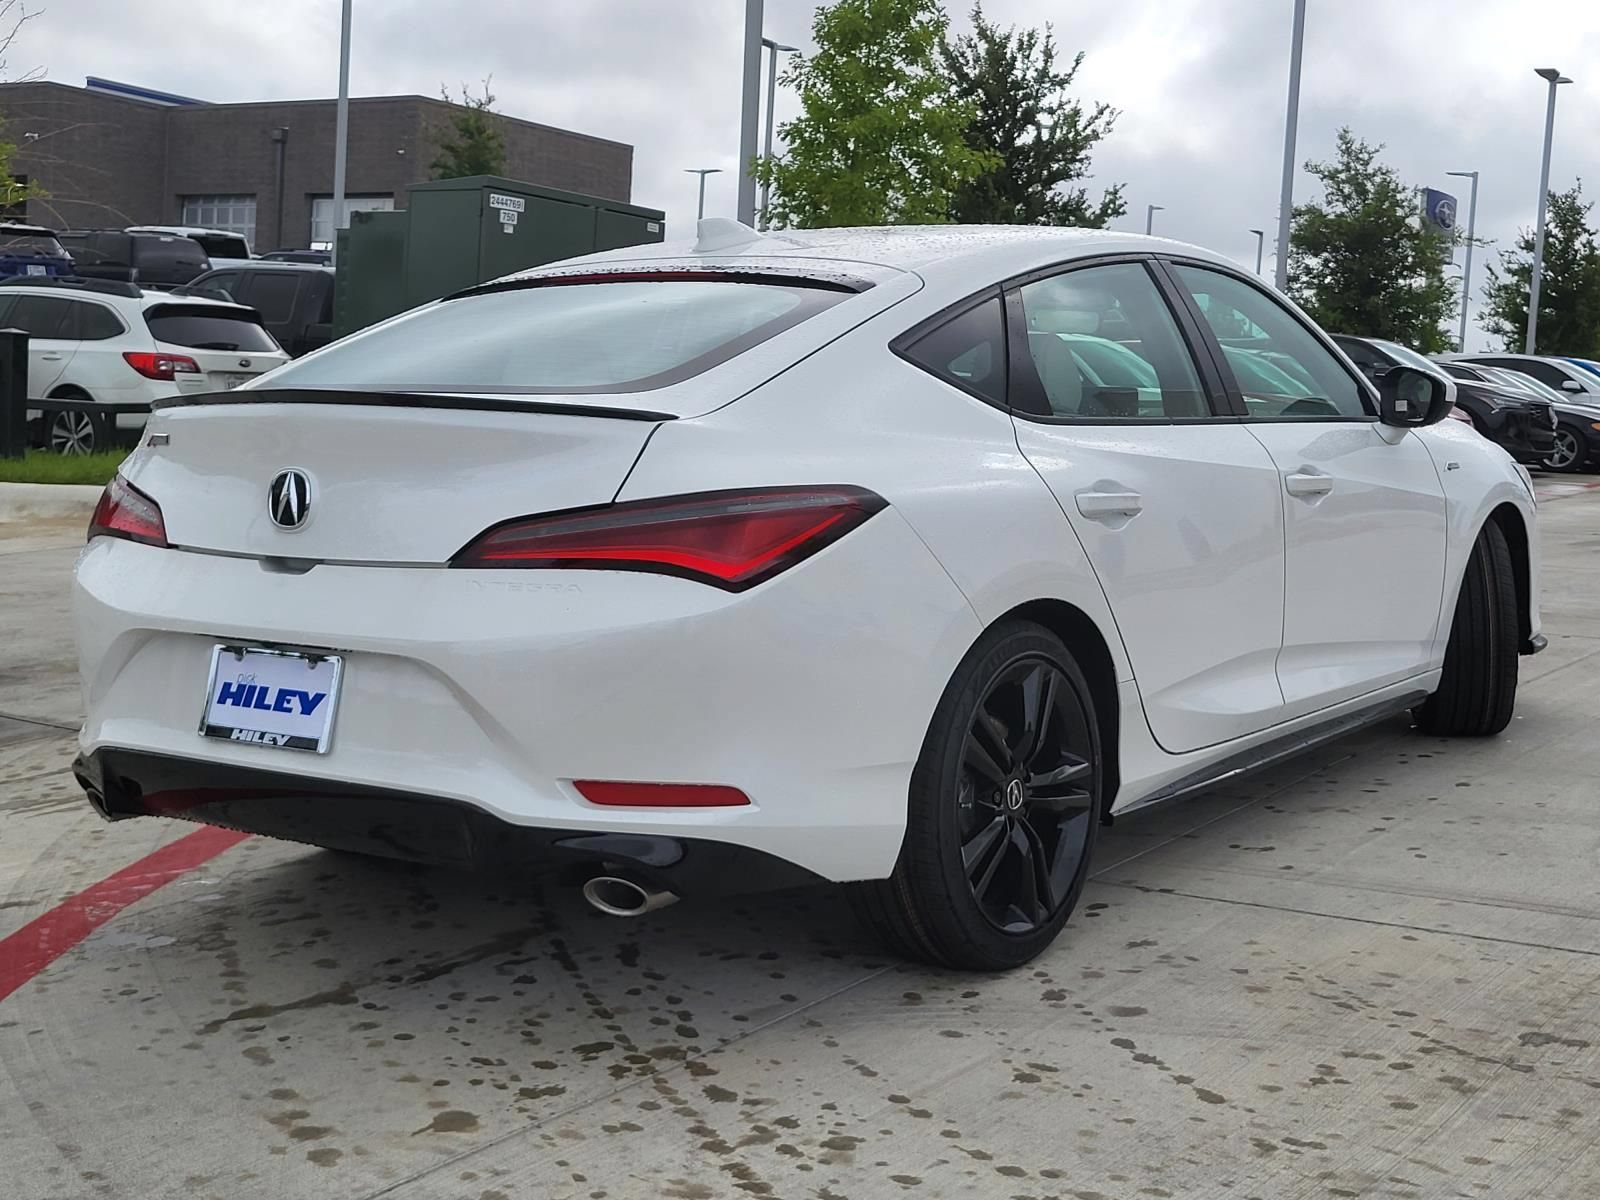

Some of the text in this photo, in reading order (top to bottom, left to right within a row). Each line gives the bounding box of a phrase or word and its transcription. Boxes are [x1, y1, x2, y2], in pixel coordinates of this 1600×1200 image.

[502, 211, 516, 222] 750
[217, 682, 326, 715] HILEY
[231, 729, 290, 745] HILEY
